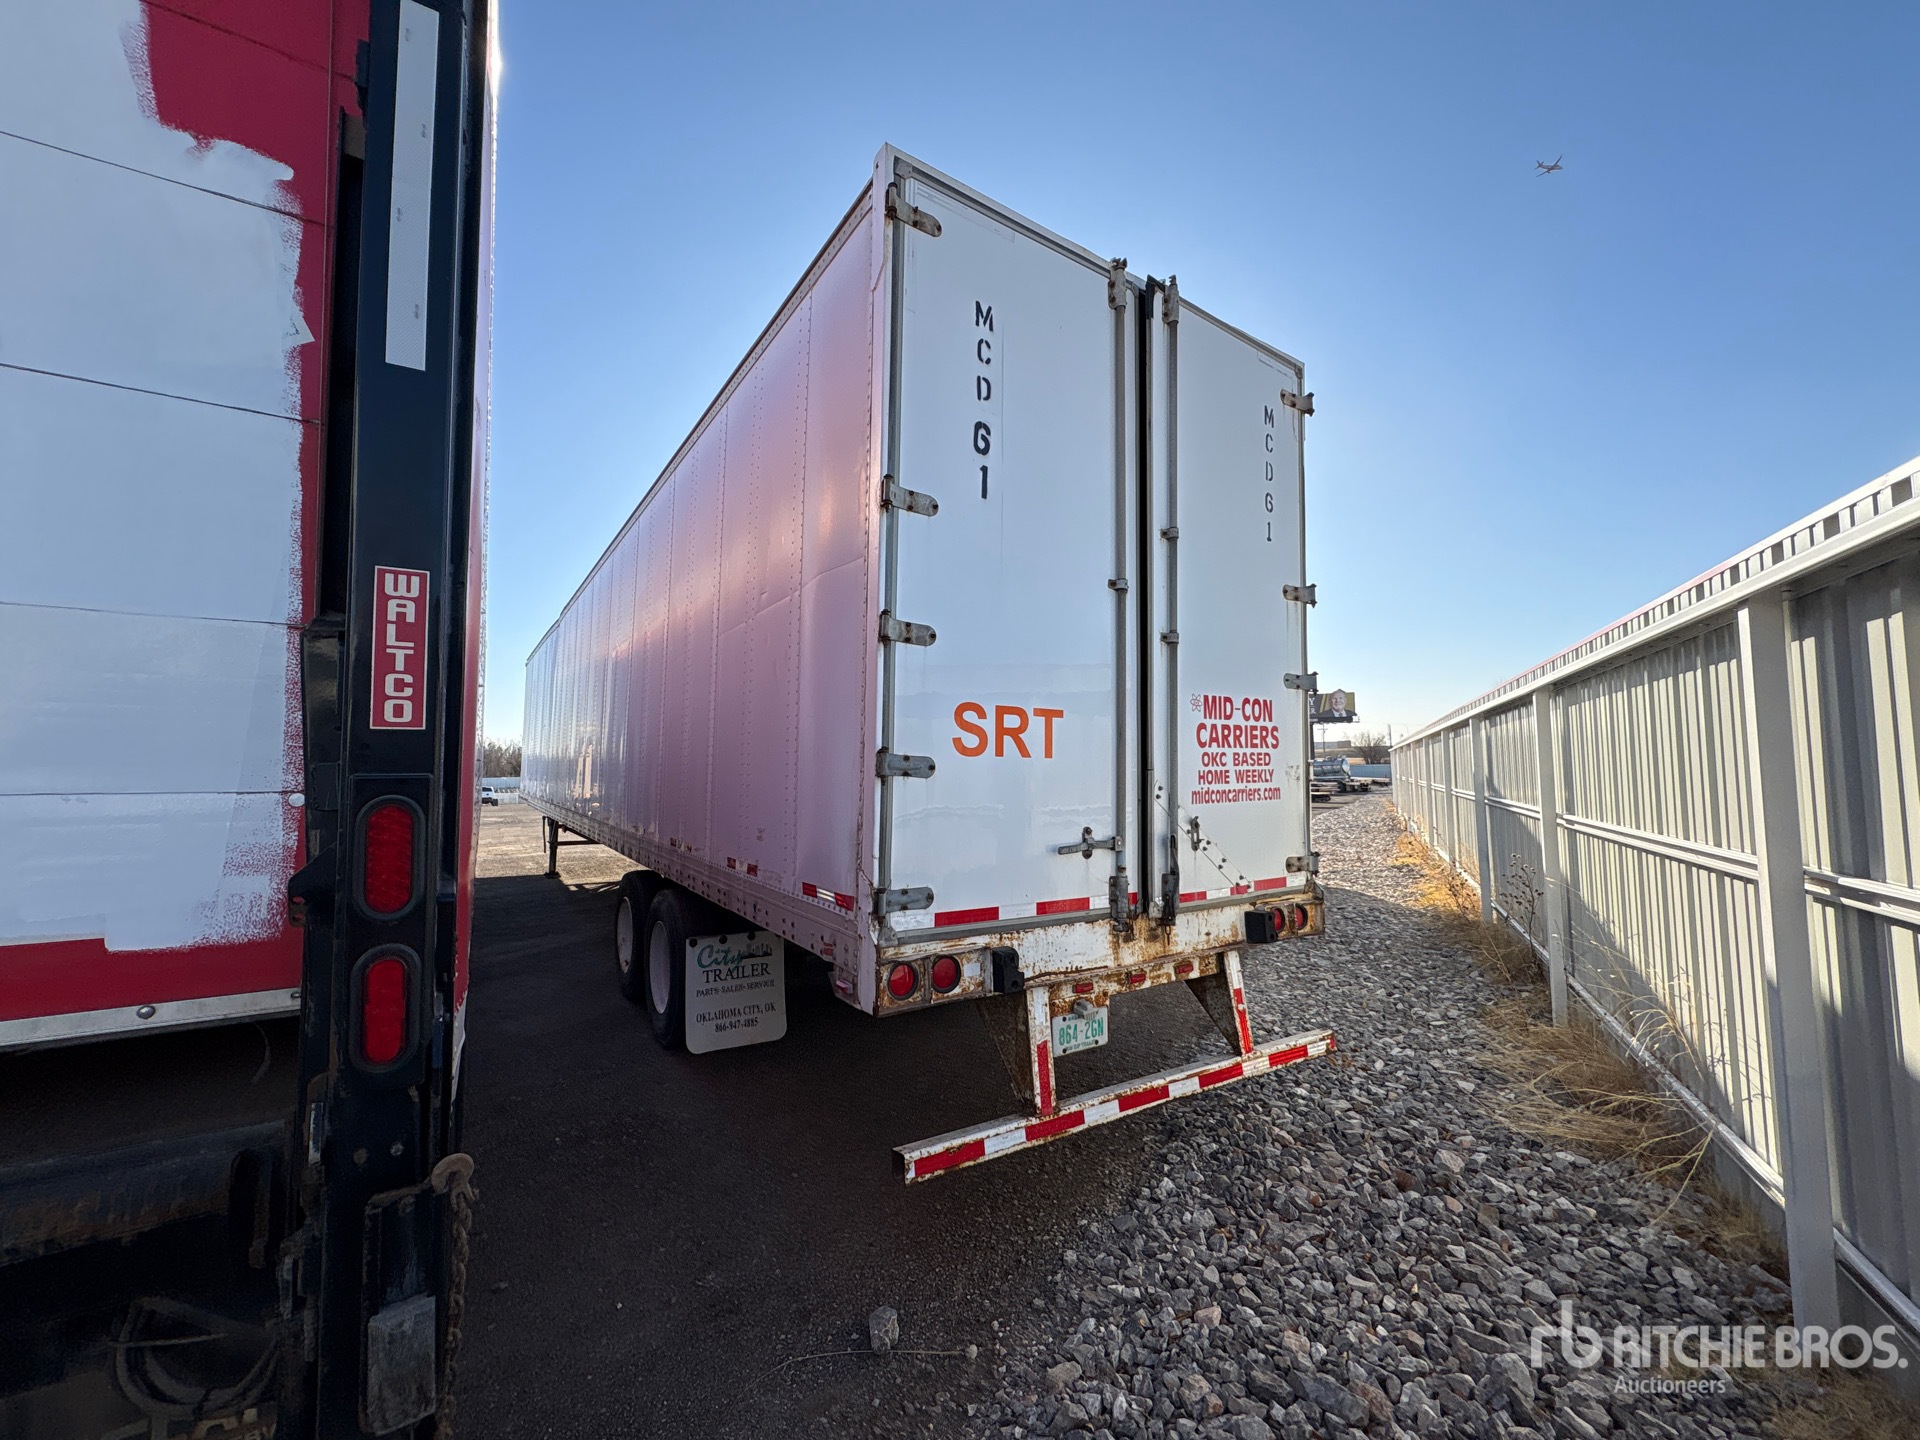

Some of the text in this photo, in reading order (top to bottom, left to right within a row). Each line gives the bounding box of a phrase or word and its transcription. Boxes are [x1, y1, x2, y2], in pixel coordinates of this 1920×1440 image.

[383, 573, 420, 723] WALTCO
[1203, 694, 1273, 722] MID-CON
[952, 701, 1064, 759] SRT
[1196, 722, 1279, 749] CARRIERS
[1201, 751, 1271, 767] OKC BASED
[1198, 768, 1274, 785] HOME WEEKLY
[1191, 785, 1281, 805] midconcarriers.com
[697, 944, 743, 971] City
[702, 962, 771, 983] TRAILER
[696, 1007, 742, 1024] OKLAHOMA
